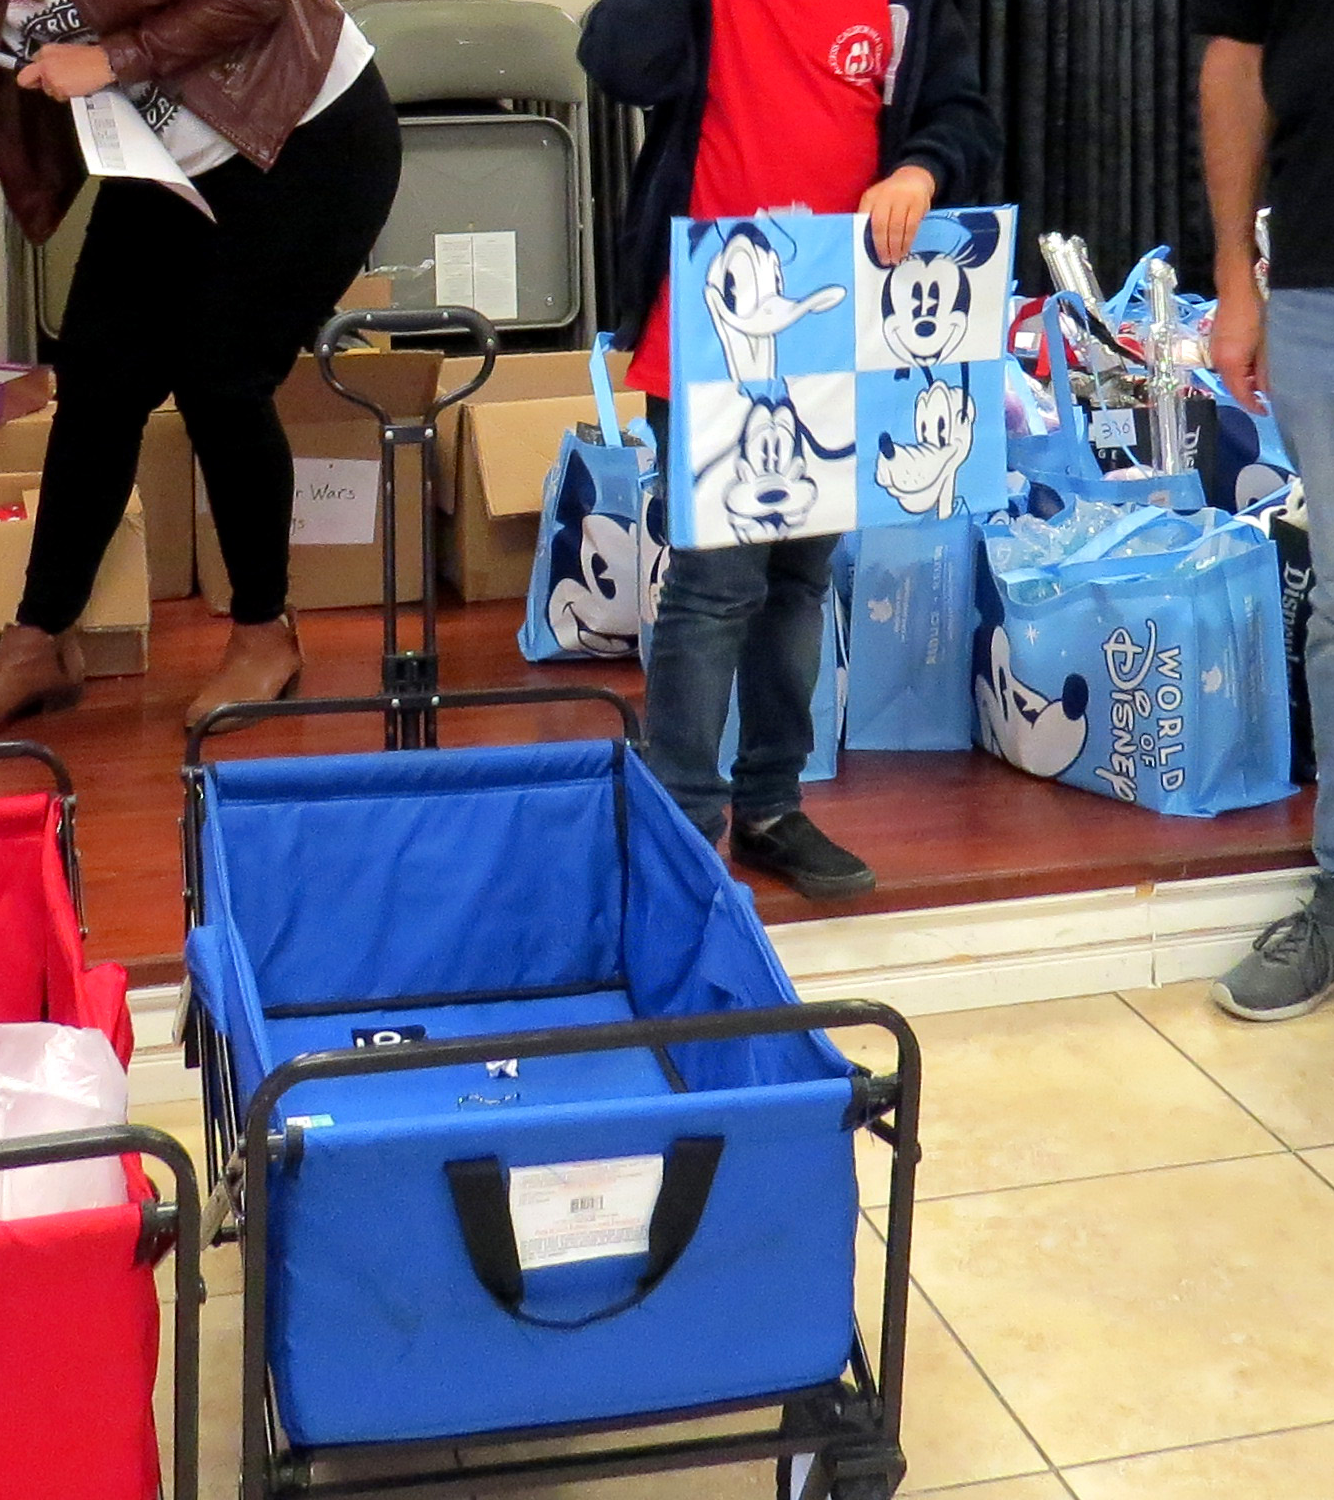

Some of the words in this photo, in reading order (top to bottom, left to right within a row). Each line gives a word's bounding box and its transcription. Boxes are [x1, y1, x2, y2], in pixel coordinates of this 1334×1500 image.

[310, 484, 356, 500] Wars
[1156, 646, 1185, 792] WORLD
[1140, 733, 1156, 769] OF
